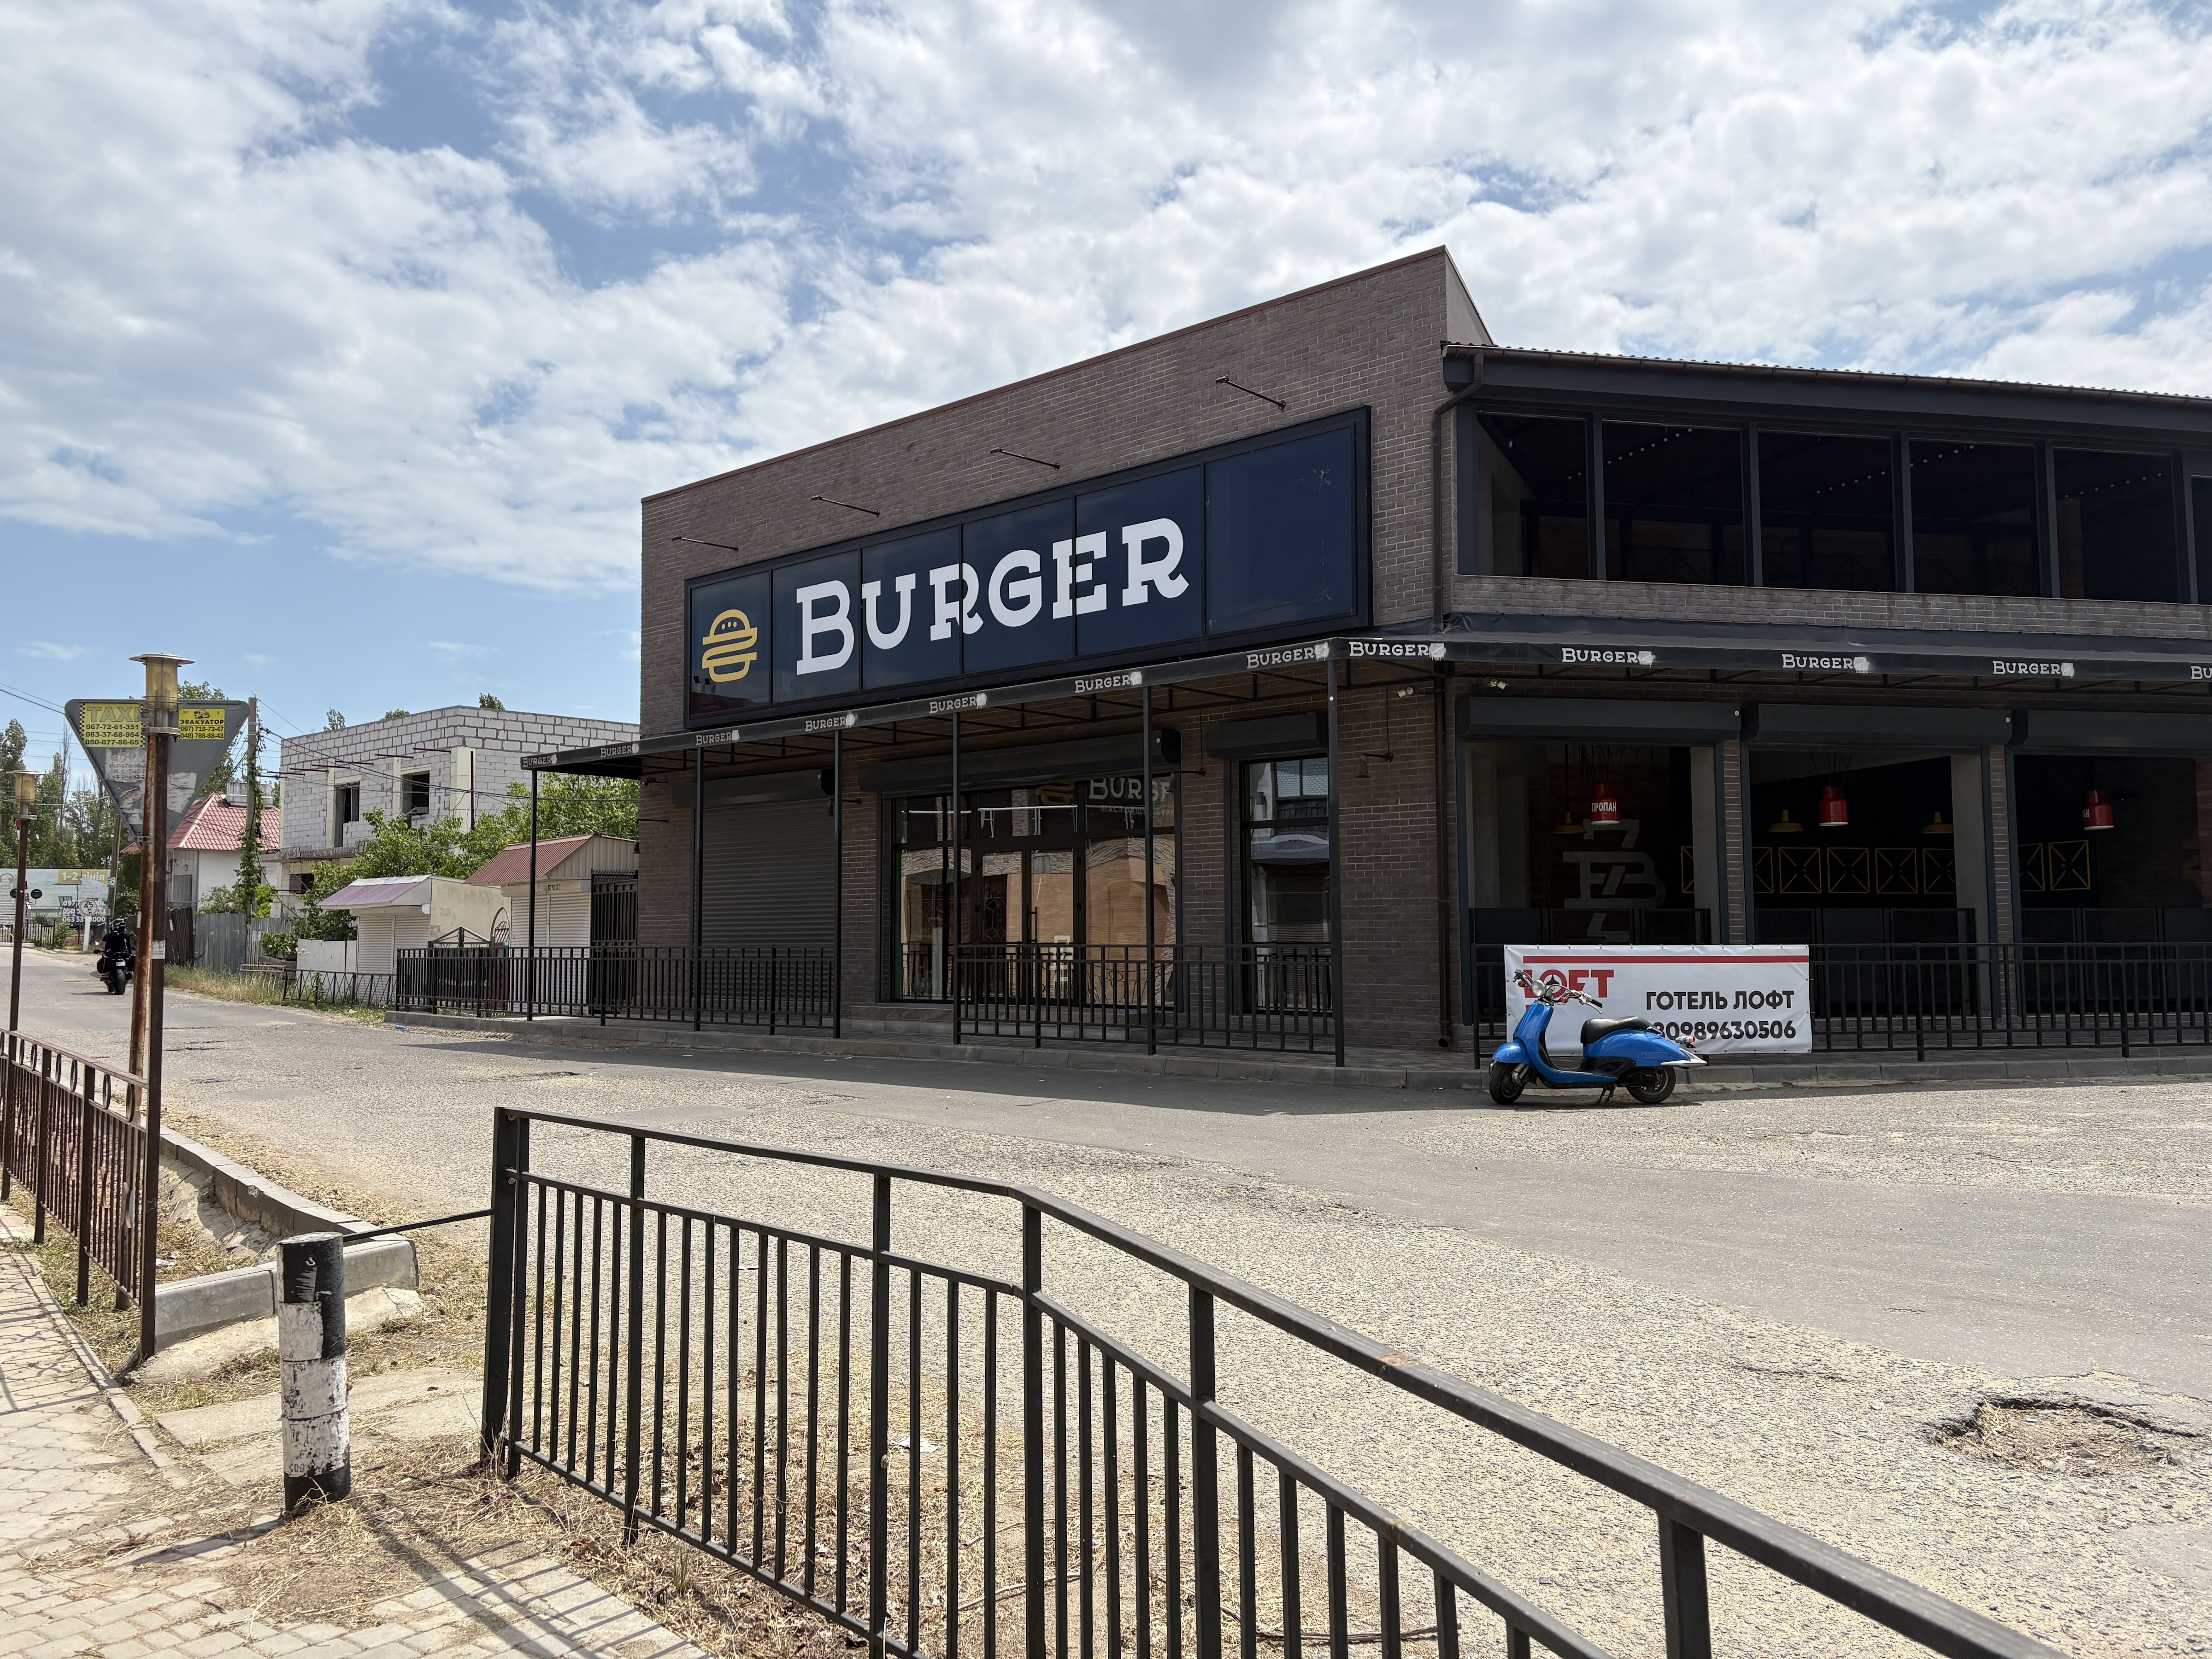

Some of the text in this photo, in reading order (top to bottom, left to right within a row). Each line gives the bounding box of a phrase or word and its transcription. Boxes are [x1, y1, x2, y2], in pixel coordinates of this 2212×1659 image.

[795, 517, 1190, 676] BURGER
[1592, 802, 1617, 812] ПРОПАН
[62, 872, 78, 881] 1-2
[1523, 969, 1614, 998] LOFT
[1646, 990, 1795, 1010] ГОТЕЛЬ ЛОФТ
